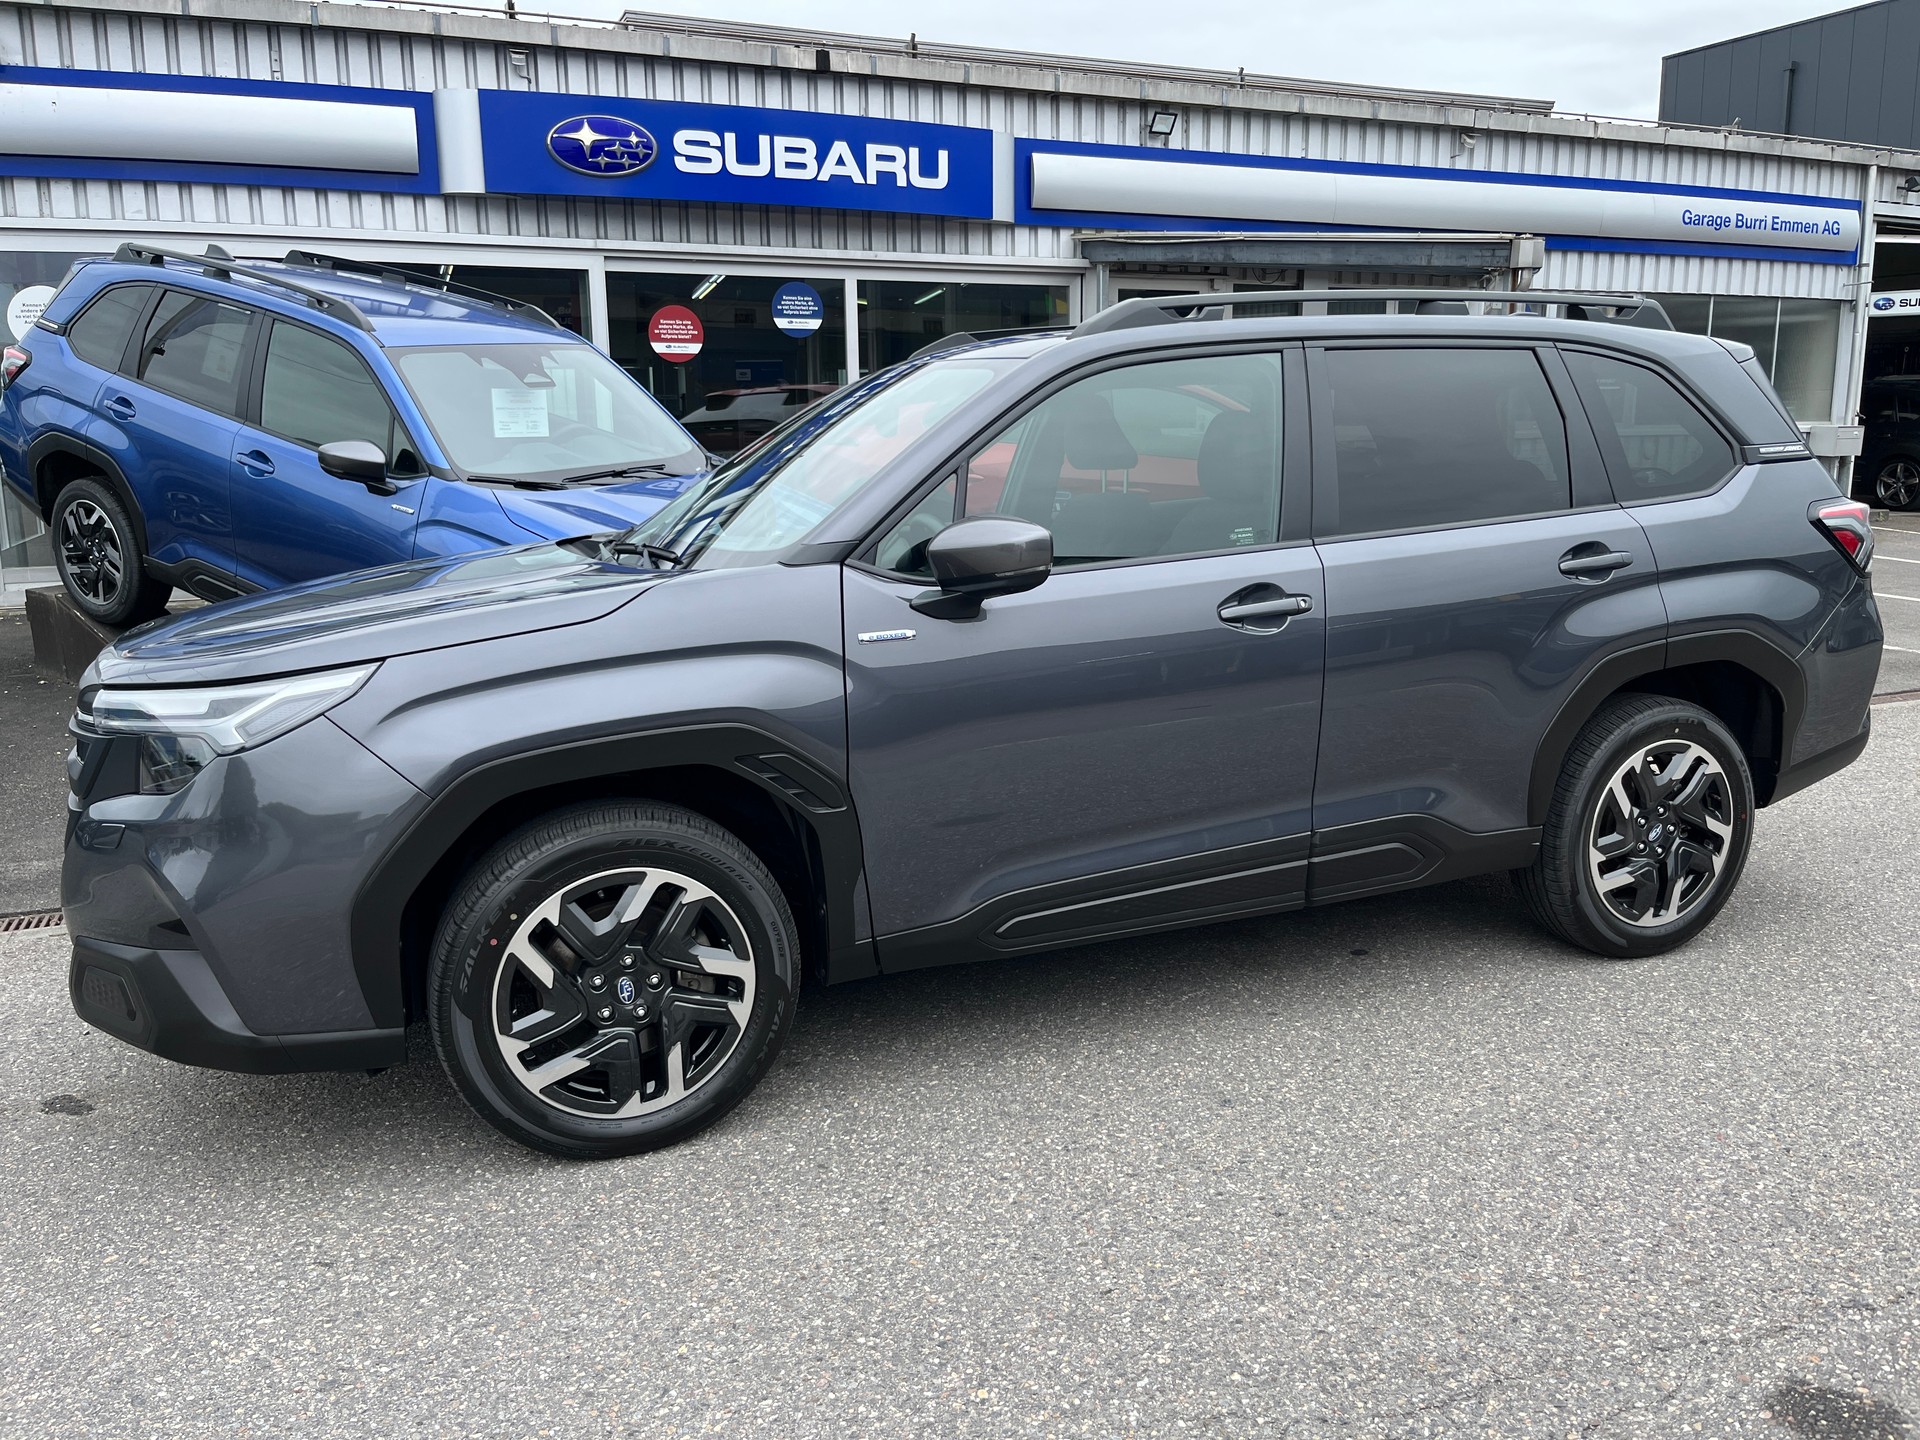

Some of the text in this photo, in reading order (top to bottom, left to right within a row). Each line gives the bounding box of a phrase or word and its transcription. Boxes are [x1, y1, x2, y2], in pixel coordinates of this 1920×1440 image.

[673, 129, 949, 190] SUBARU
[1682, 209, 1840, 236] Garage Burri Emmen AG
[1899, 298, 1920, 307] SU
